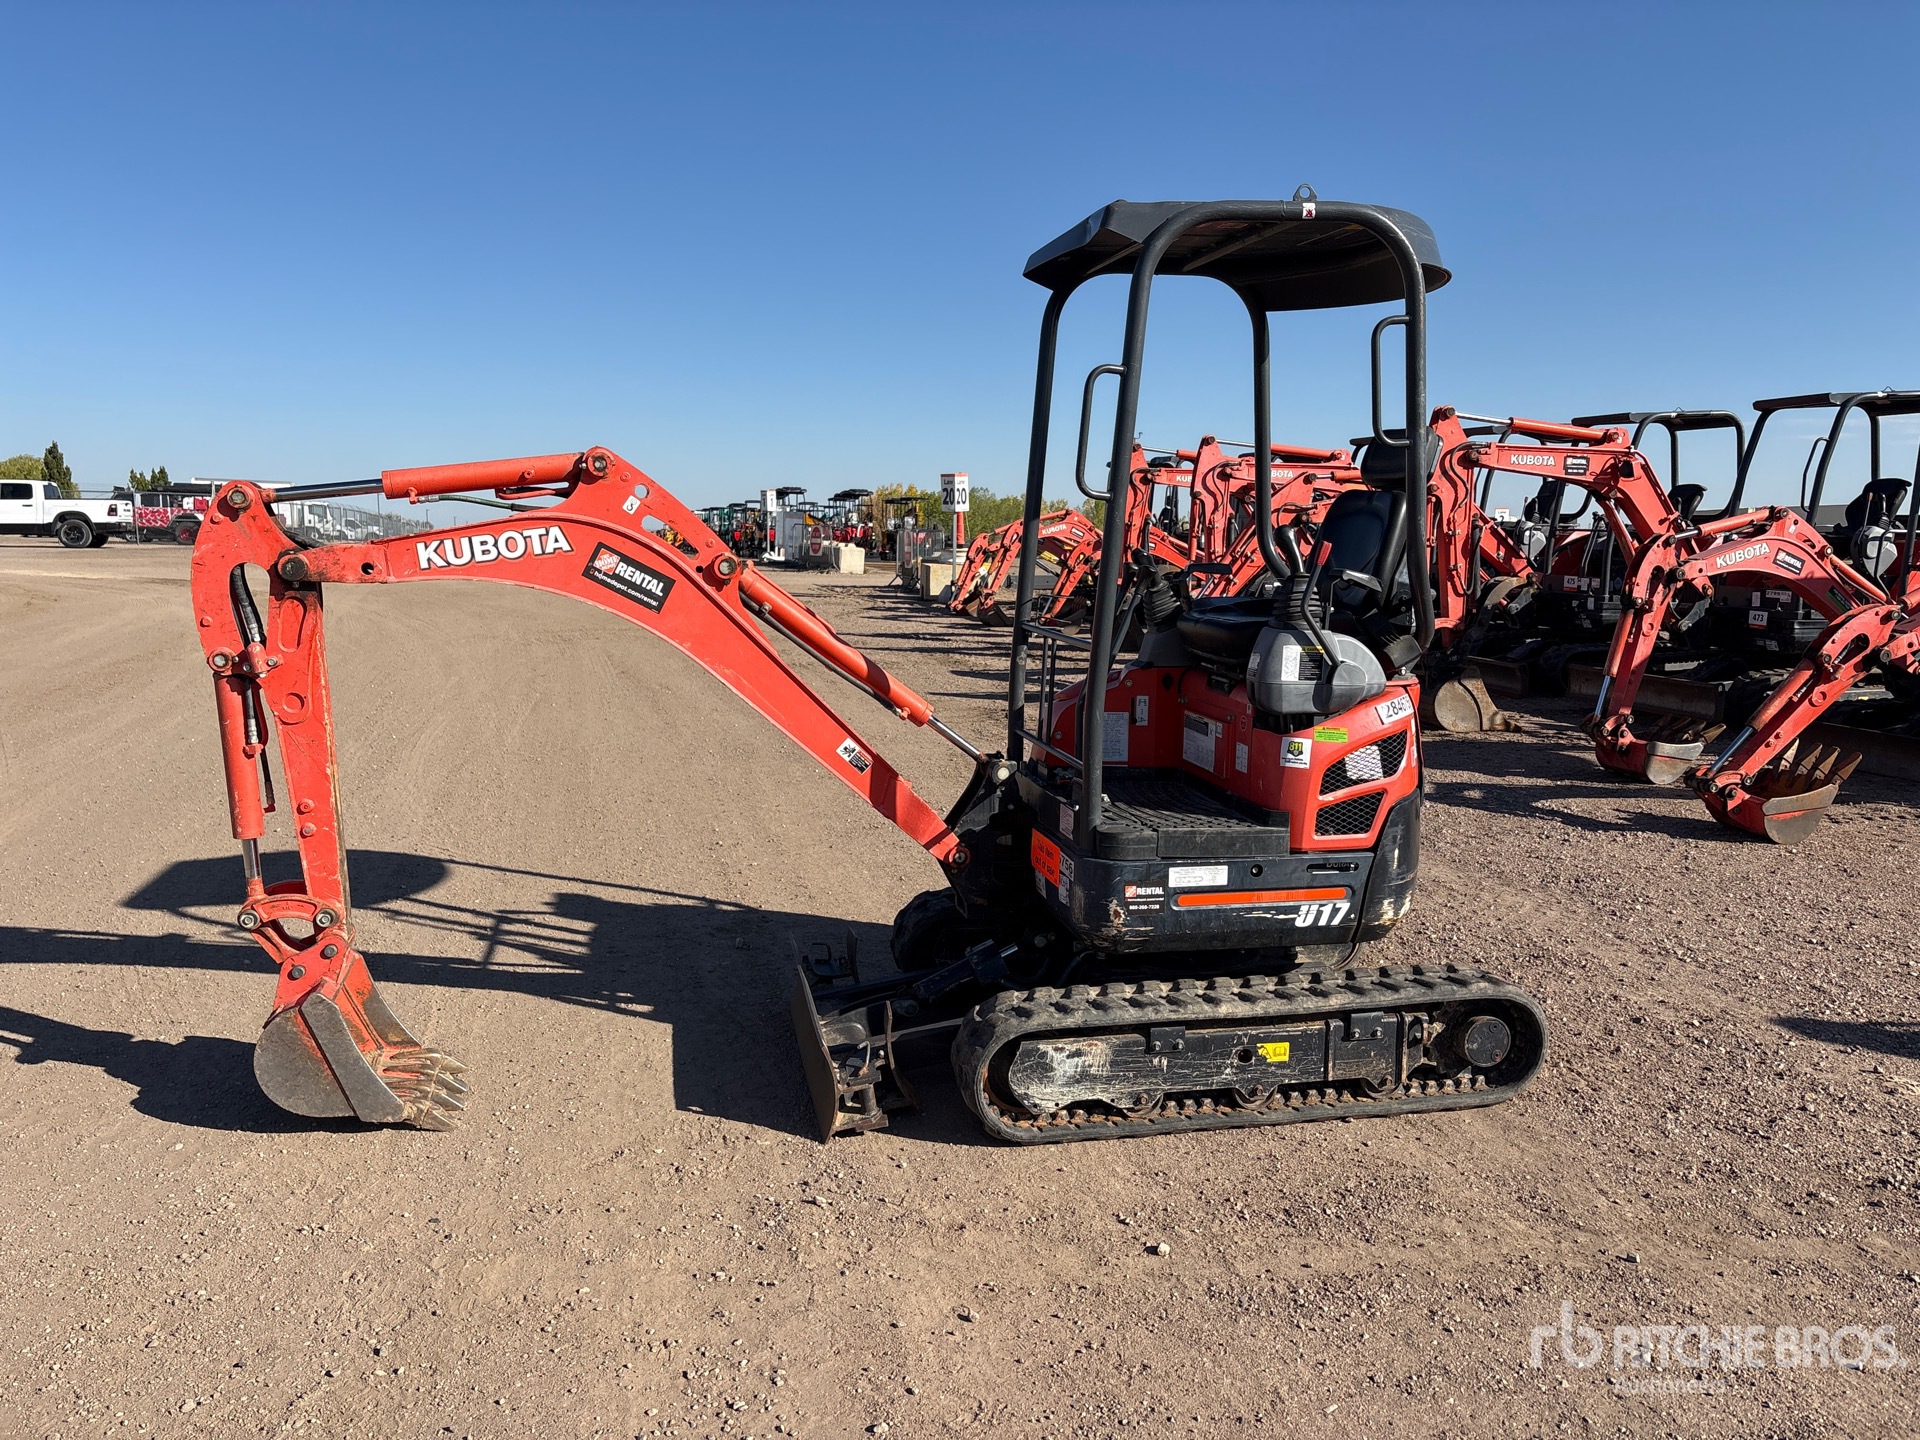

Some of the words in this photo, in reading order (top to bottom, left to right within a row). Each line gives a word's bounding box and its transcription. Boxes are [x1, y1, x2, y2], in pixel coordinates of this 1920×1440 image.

[1510, 454, 1555, 466] KUBOTA
[942, 487, 955, 506] 20
[956, 487, 967, 505] 20
[1041, 523, 1068, 536] KUBOTA
[416, 526, 573, 571] KUBOTA
[1715, 542, 1771, 569] KUBOTA
[614, 561, 664, 597] RENTAL
[1752, 613, 1764, 622] 473
[1289, 741, 1302, 752] 811
[1136, 886, 1165, 896] RENTAL
[1294, 902, 1351, 928] U17
